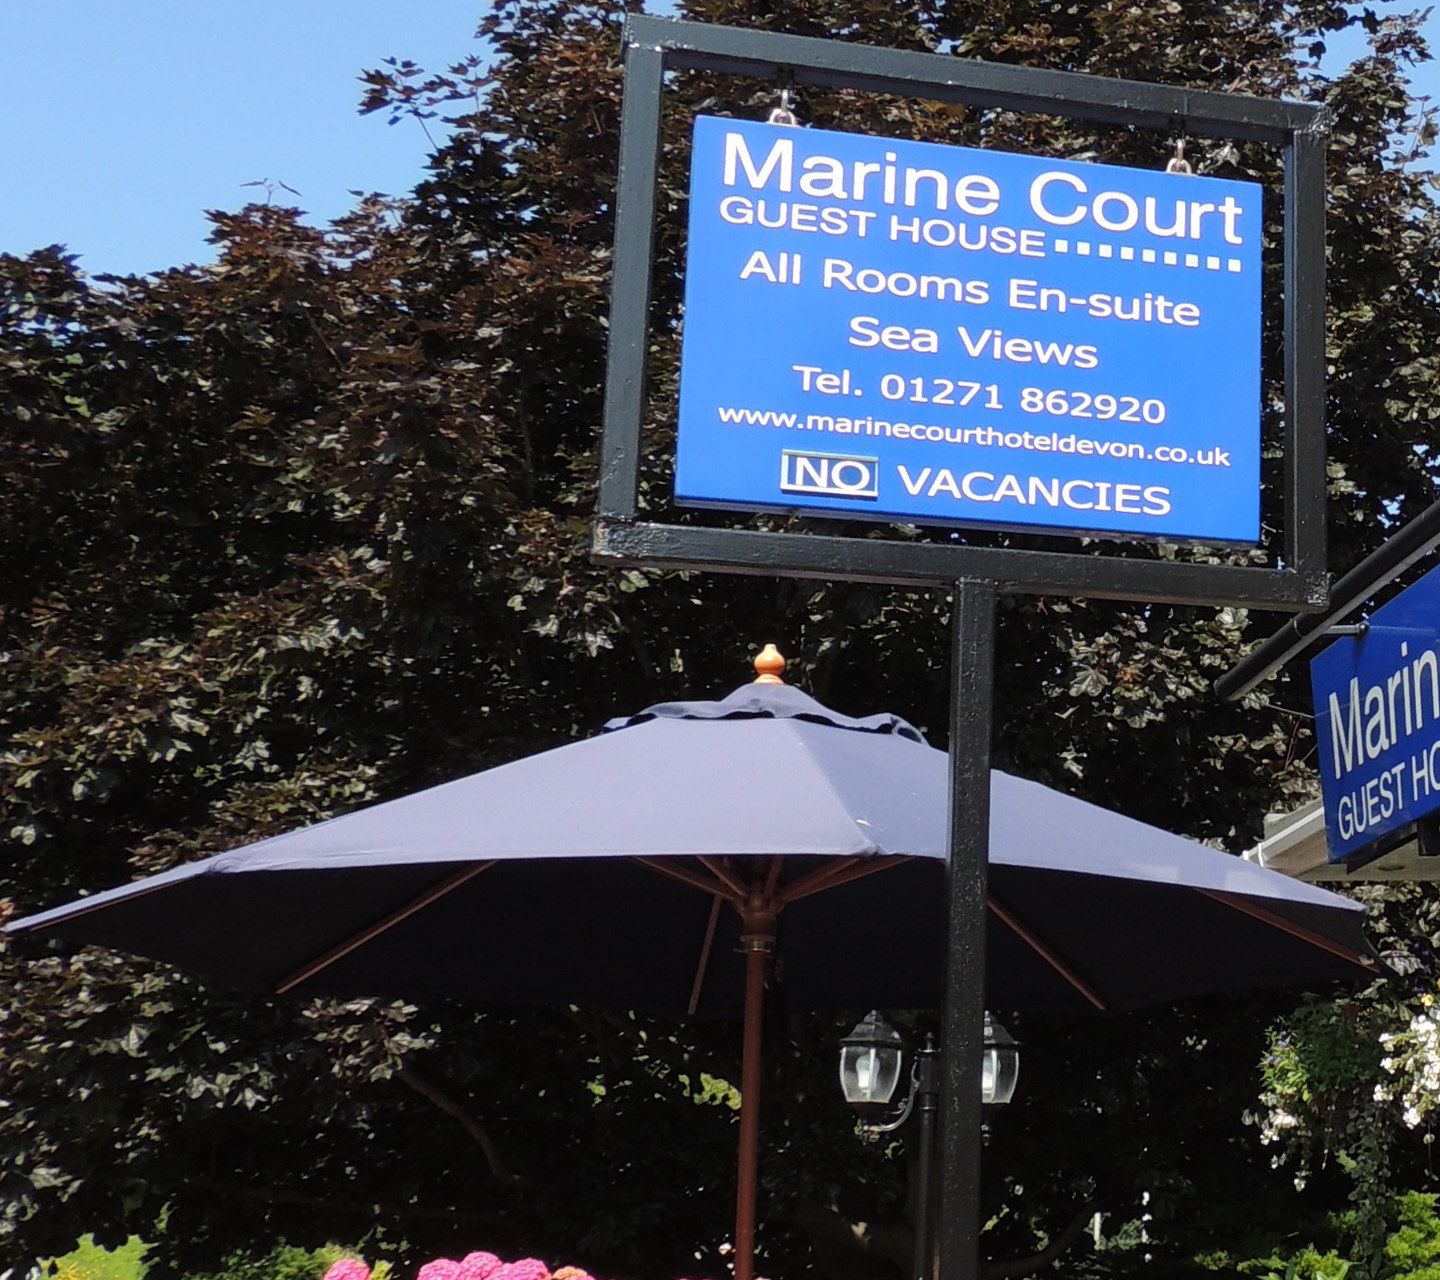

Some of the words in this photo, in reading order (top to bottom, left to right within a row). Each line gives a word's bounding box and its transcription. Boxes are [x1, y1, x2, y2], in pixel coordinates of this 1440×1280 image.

[724, 133, 1000, 216] Marine
[1030, 172, 1242, 245] Court
[720, 196, 876, 238] GUEST
[890, 215, 1046, 258] HOUSE
[740, 250, 801, 285] All
[823, 259, 989, 305] Rooms
[1009, 279, 1201, 327] En-suite
[849, 315, 939, 355] Sea
[958, 326, 1099, 369] Views
[793, 365, 863, 397] Tel.
[881, 374, 1004, 410] 01271
[1021, 387, 1166, 425] 862920
[718, 406, 1231, 467] www.marinecourthoteldevon.co.uk
[793, 455, 870, 492] NO
[898, 464, 1171, 516] VACANCIES
[1338, 762, 1405, 841] GUEST
